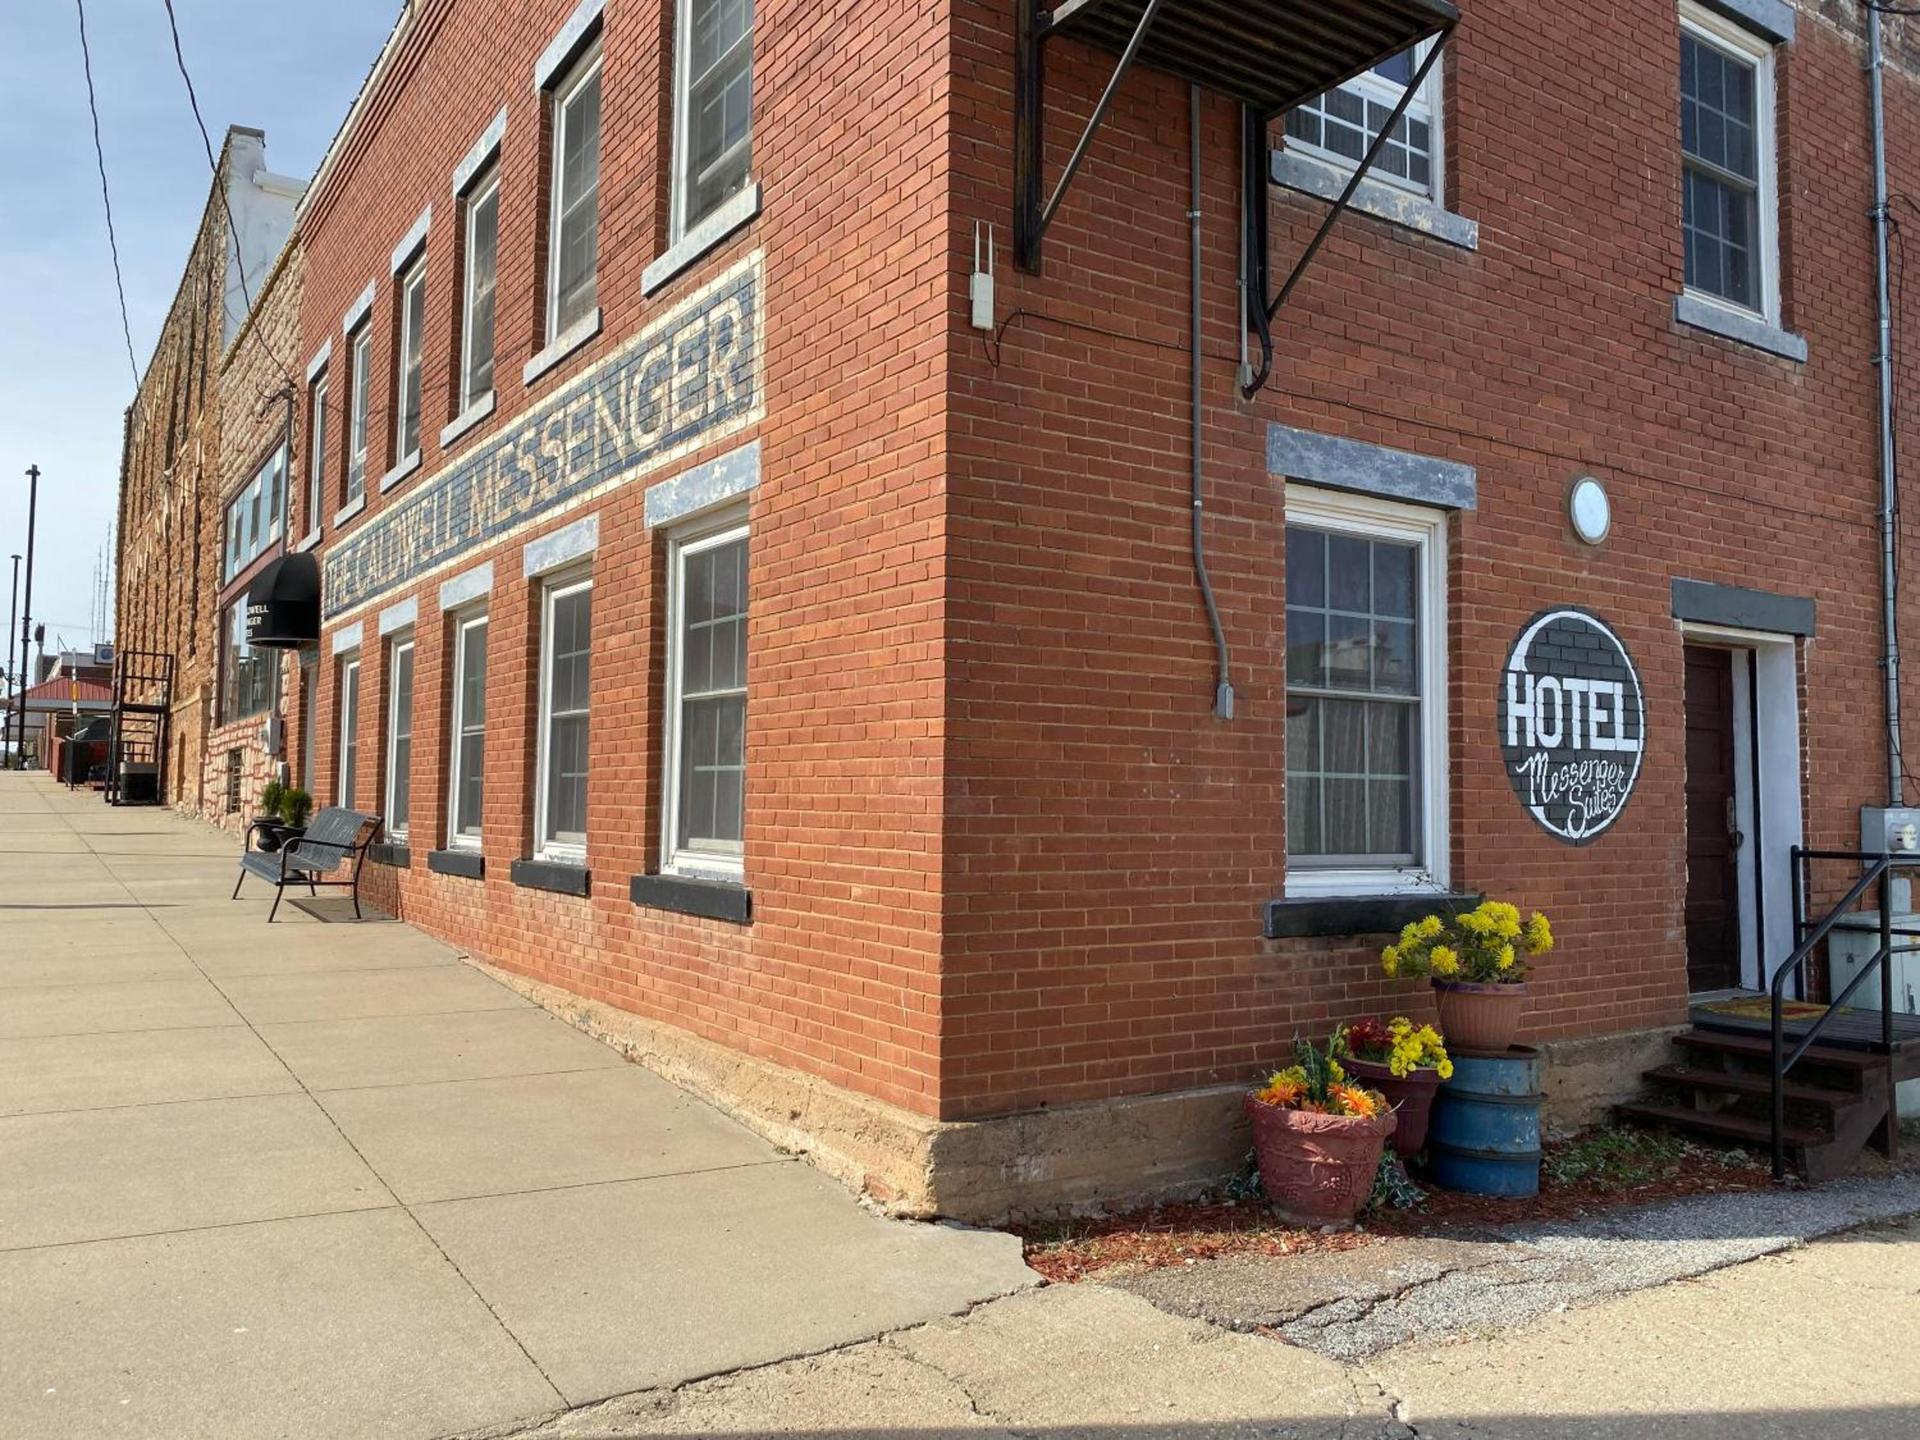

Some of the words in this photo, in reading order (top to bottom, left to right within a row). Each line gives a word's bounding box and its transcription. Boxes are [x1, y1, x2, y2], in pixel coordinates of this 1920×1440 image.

[356, 483, 461, 597] CALDWELL
[467, 297, 743, 539] MESSENGER
[1507, 673, 1640, 752] HOTEL
[1516, 751, 1626, 805] Messenger
[1567, 785, 1616, 838] Suites
